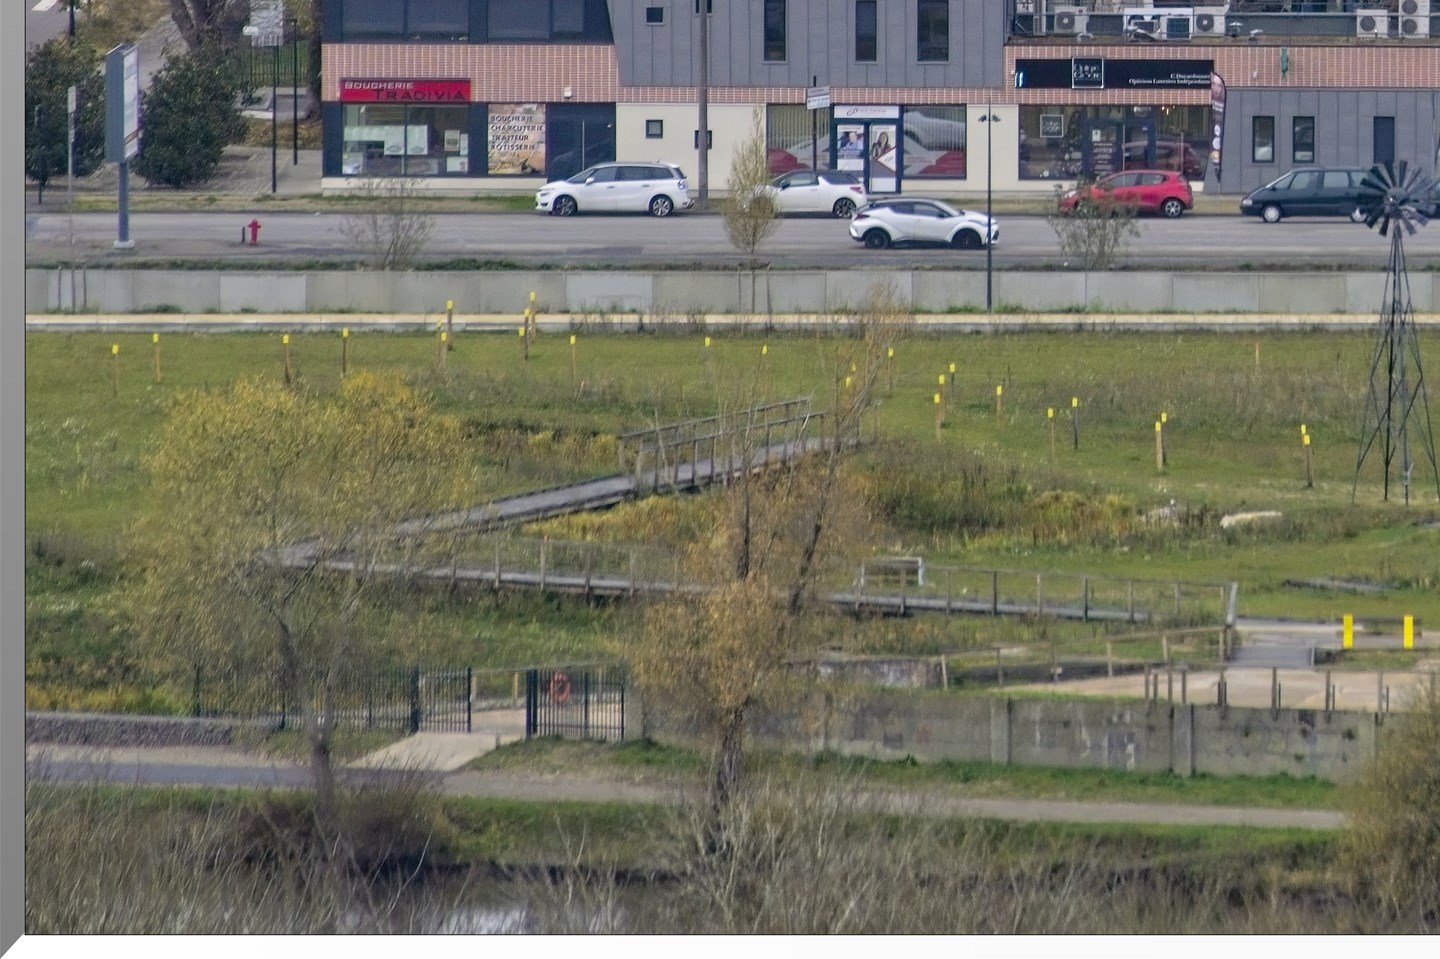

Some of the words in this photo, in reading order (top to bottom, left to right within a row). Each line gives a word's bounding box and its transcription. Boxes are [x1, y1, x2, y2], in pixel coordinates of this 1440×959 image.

[344, 81, 414, 90] BOUCHERIE
[374, 89, 466, 101] TRADIVIA
[490, 115, 533, 123] BOUCHERIE
[490, 124, 544, 132] CHARCUTERIE
